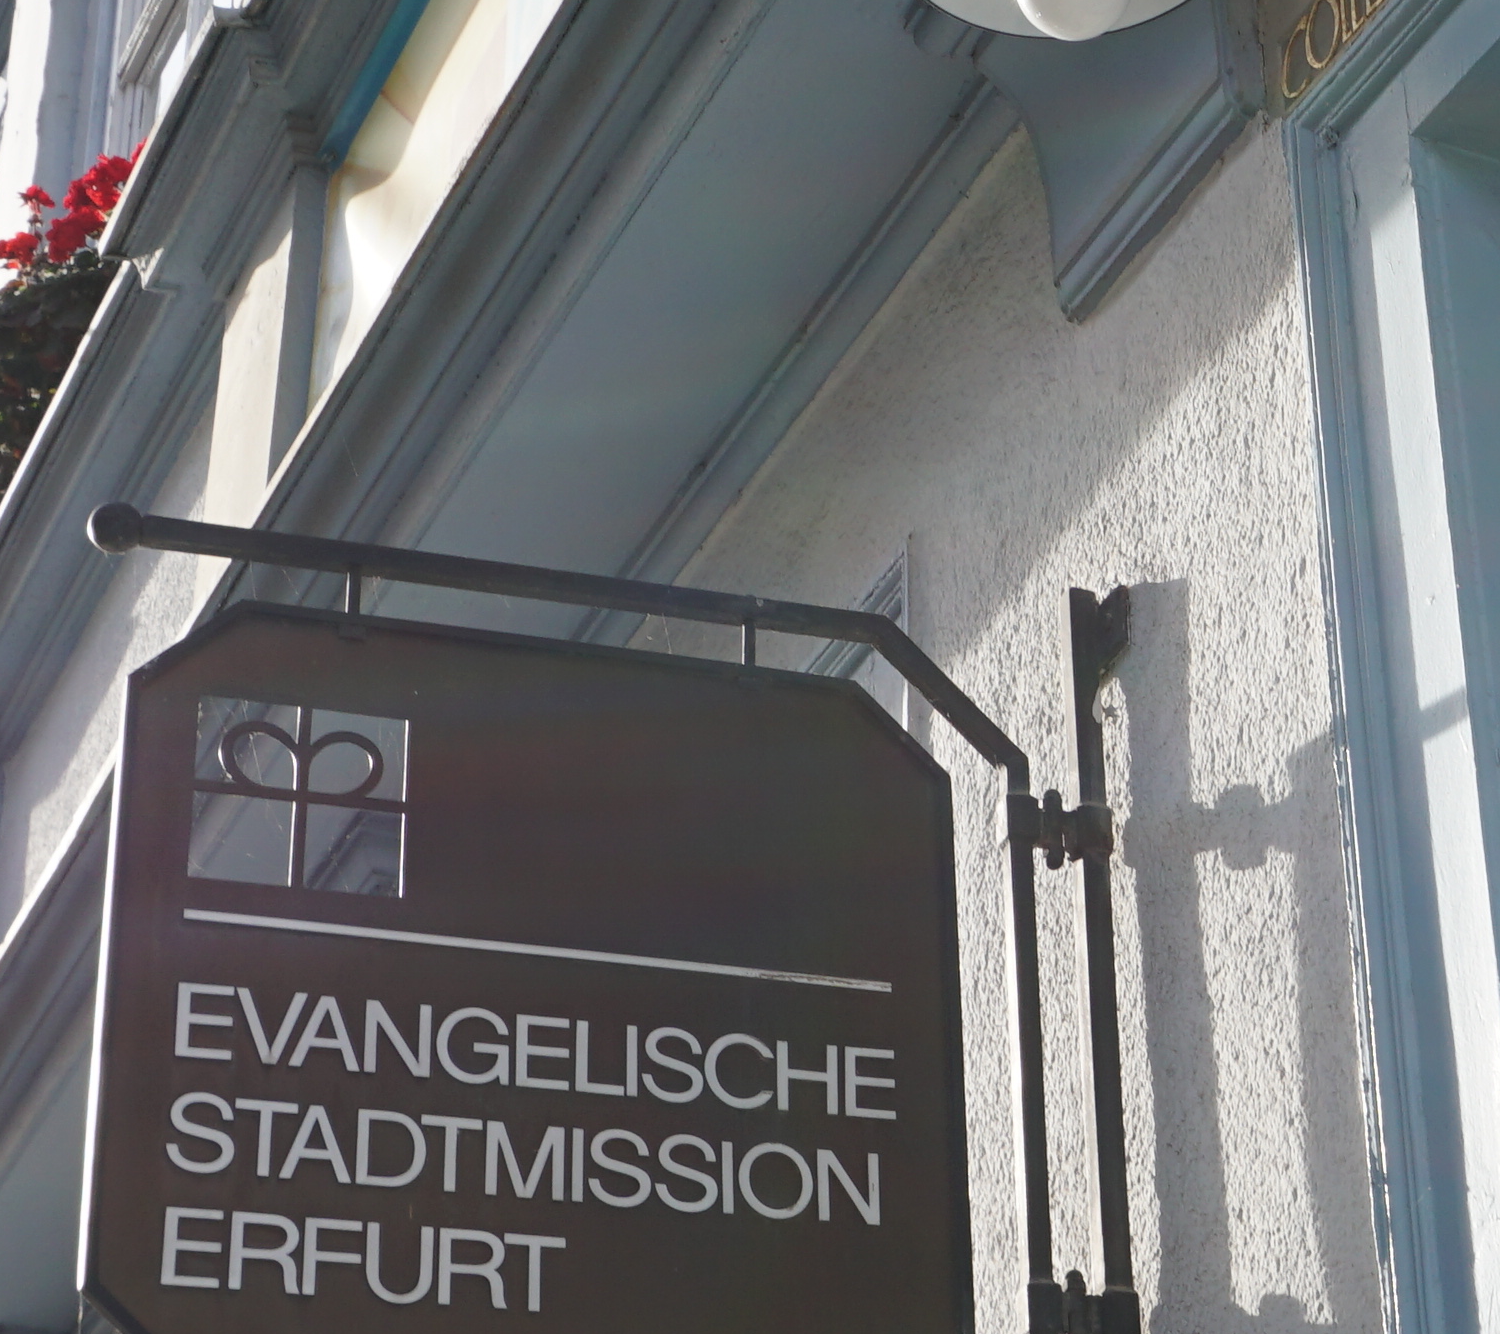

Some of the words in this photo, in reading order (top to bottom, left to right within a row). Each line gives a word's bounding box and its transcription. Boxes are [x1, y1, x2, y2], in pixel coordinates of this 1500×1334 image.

[174, 982, 898, 1121] EVANGELISCHE
[165, 1091, 881, 1227] STADTMISSION
[159, 1206, 567, 1313] ERFURT
